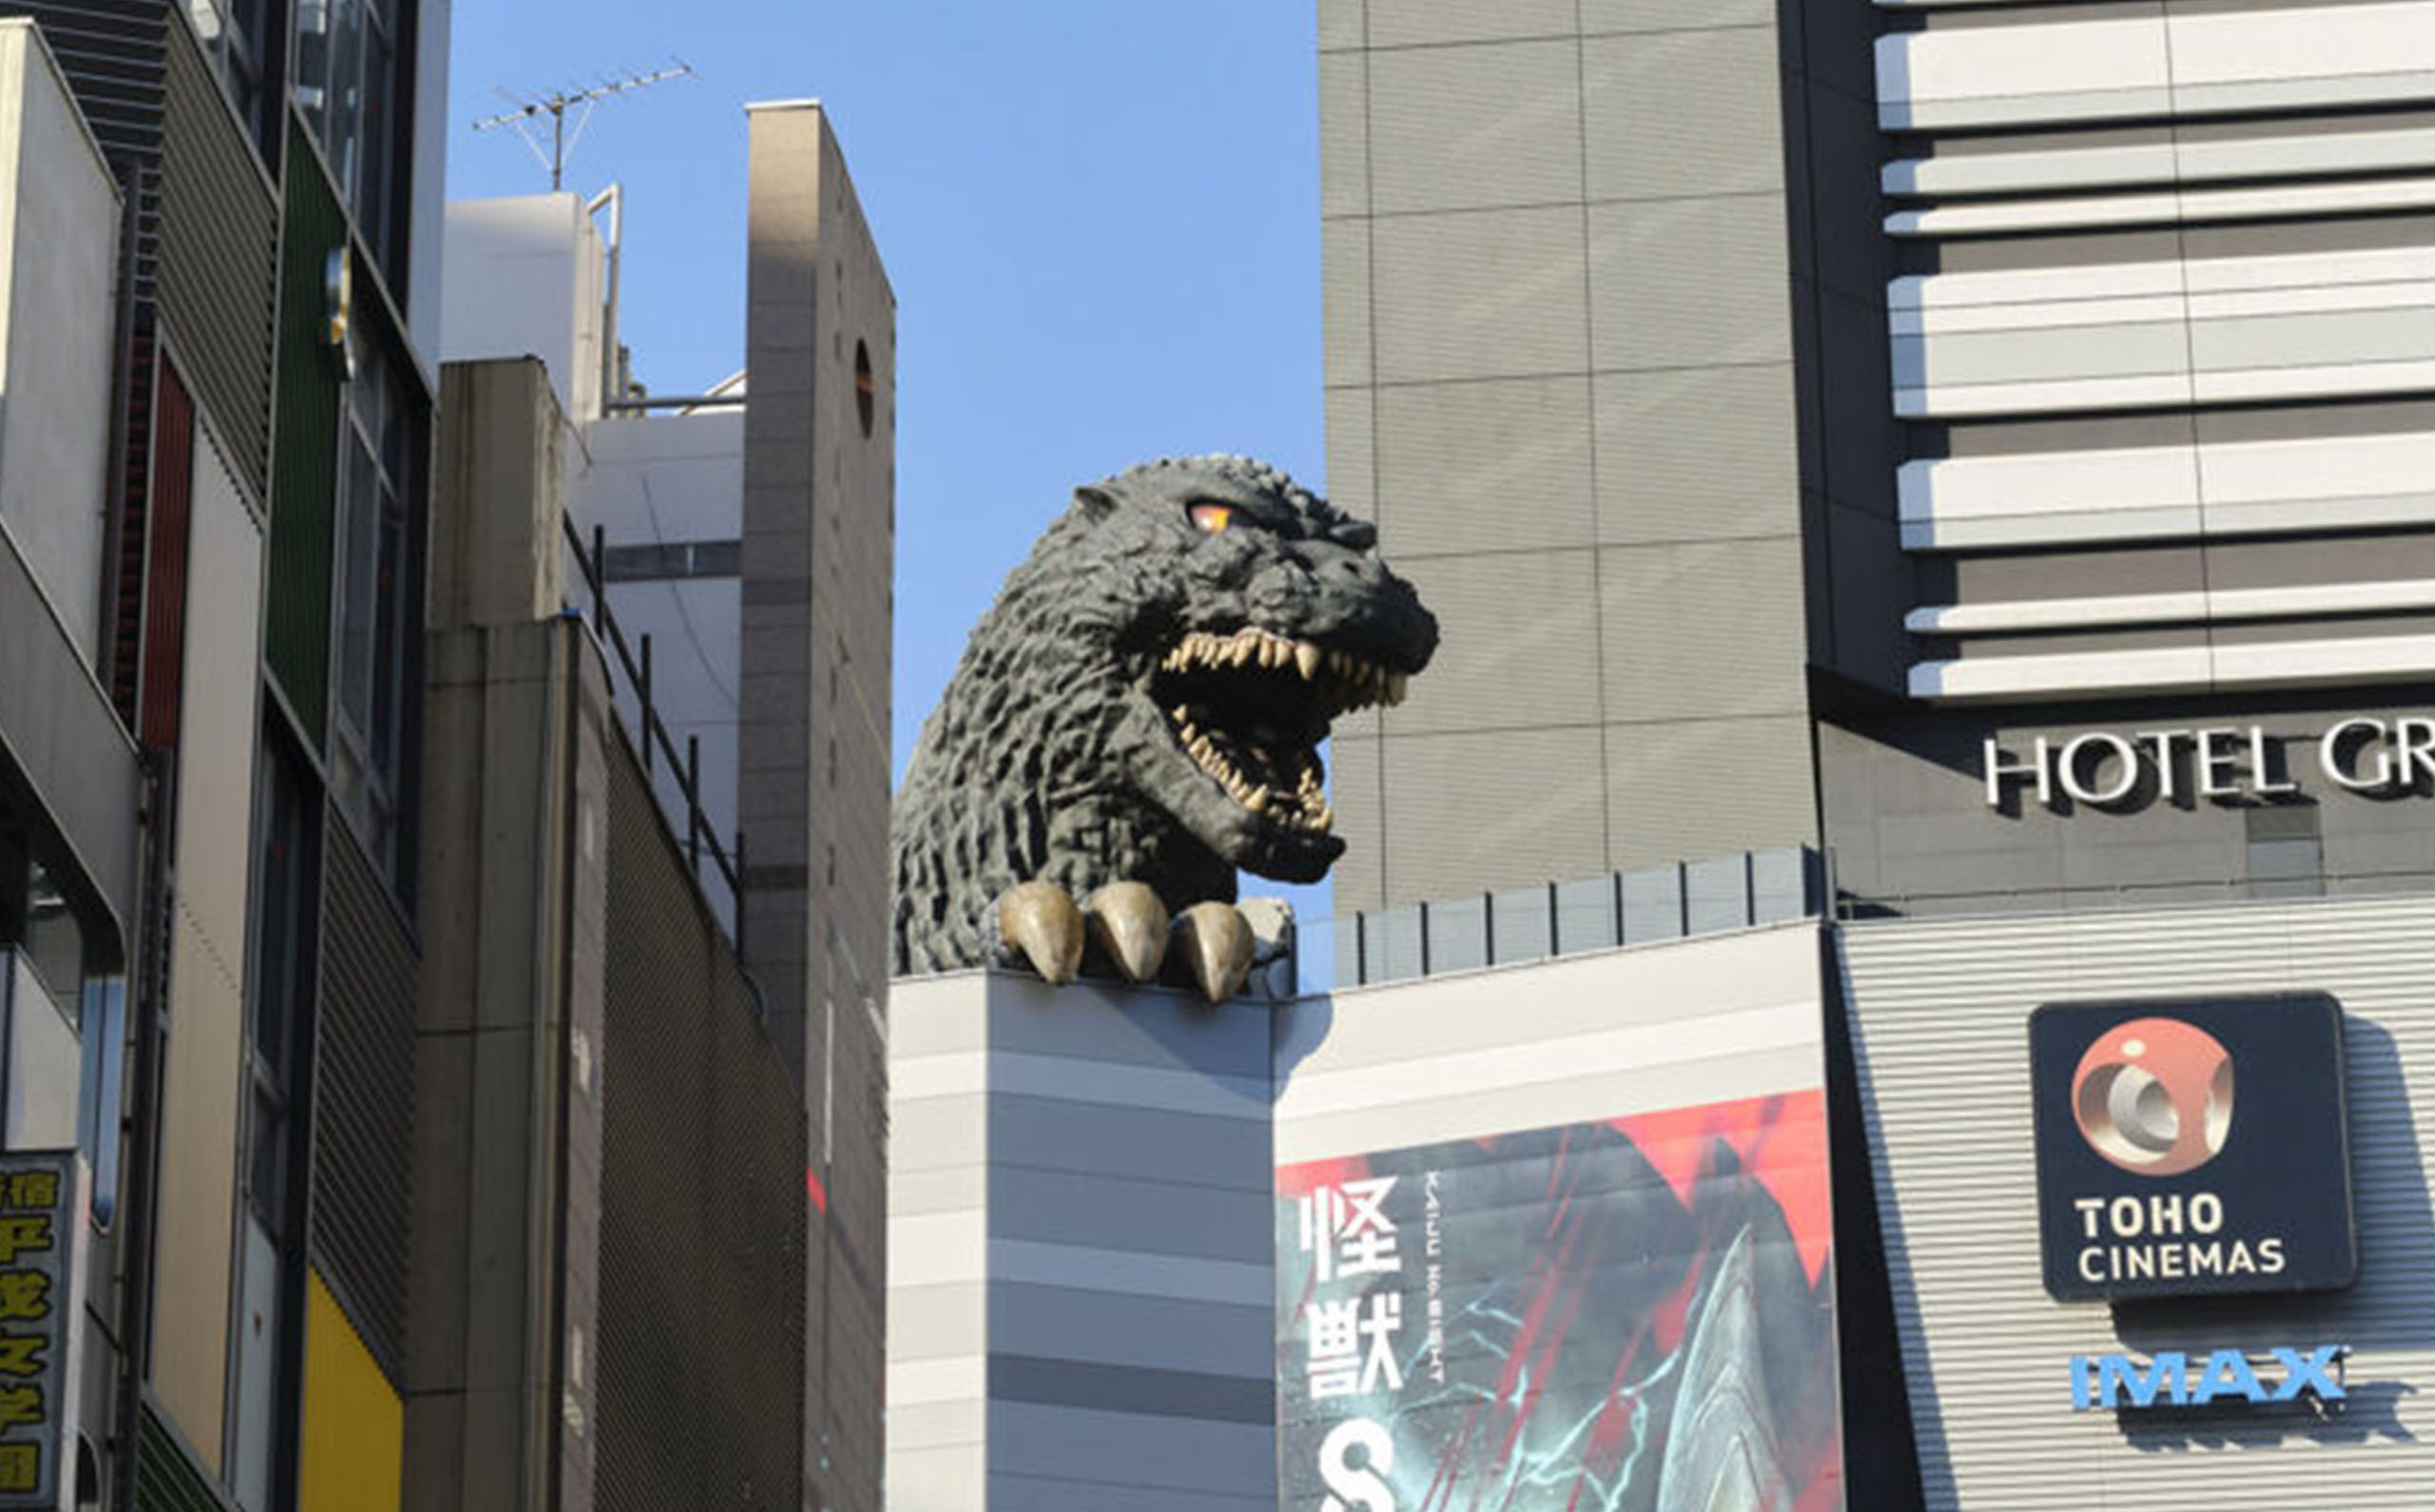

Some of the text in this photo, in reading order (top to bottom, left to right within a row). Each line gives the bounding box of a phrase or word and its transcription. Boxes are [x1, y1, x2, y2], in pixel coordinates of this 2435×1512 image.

[1984, 717, 2435, 806] HOTEL GR
[1425, 1171, 1442, 1256] KAIJU
[2075, 1192, 2223, 1238] TOHO
[2078, 1238, 2286, 1282] CINEMAS
[2069, 1345, 2347, 1411] IMAX
